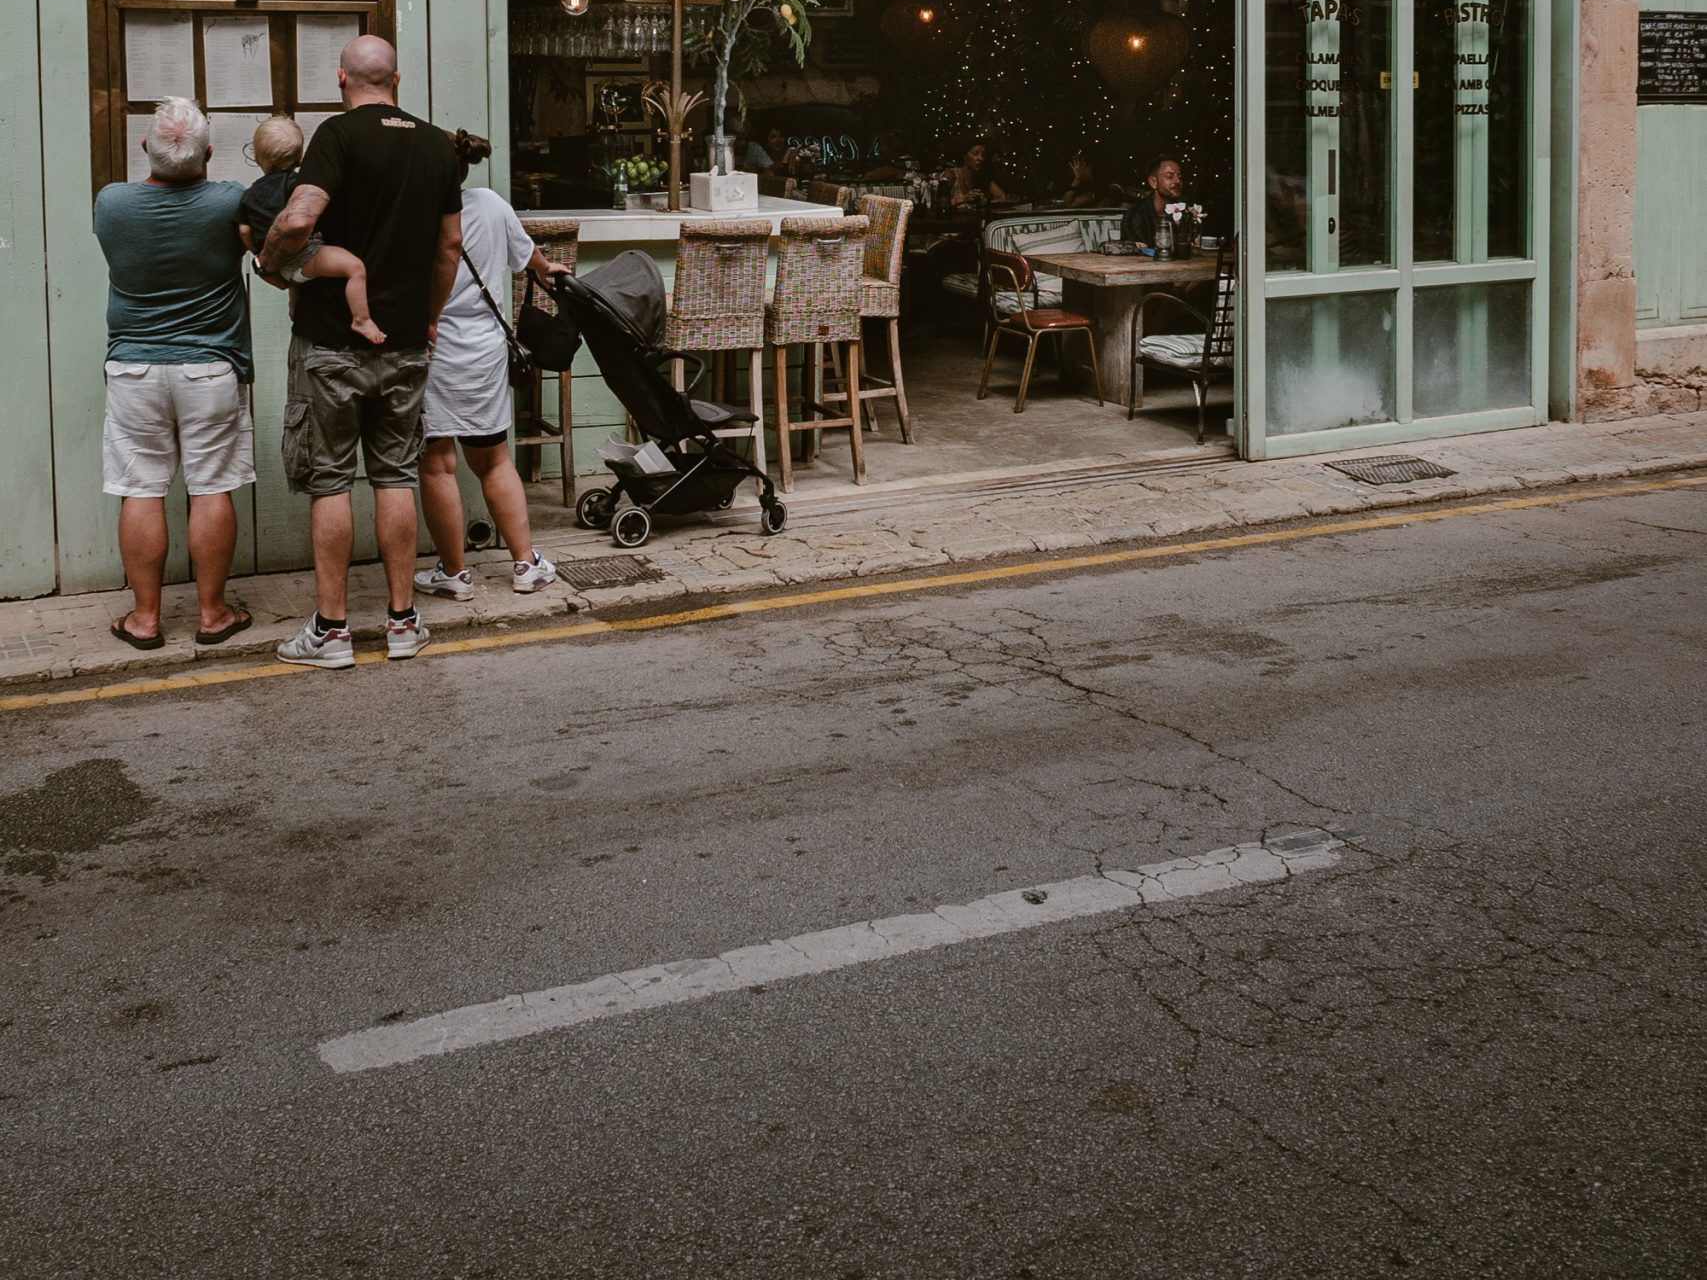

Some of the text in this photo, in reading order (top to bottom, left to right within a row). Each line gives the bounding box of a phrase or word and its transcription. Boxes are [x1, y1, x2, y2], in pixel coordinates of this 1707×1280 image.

[1297, 0, 1362, 26] TAPAS
[1443, 2, 1502, 26] BISTRO
[1296, 53, 1360, 65] CALAMAS
[1460, 79, 1482, 90] AMB
[1303, 106, 1349, 117] ALMEJ
[1454, 104, 1491, 115] PIZZAS
